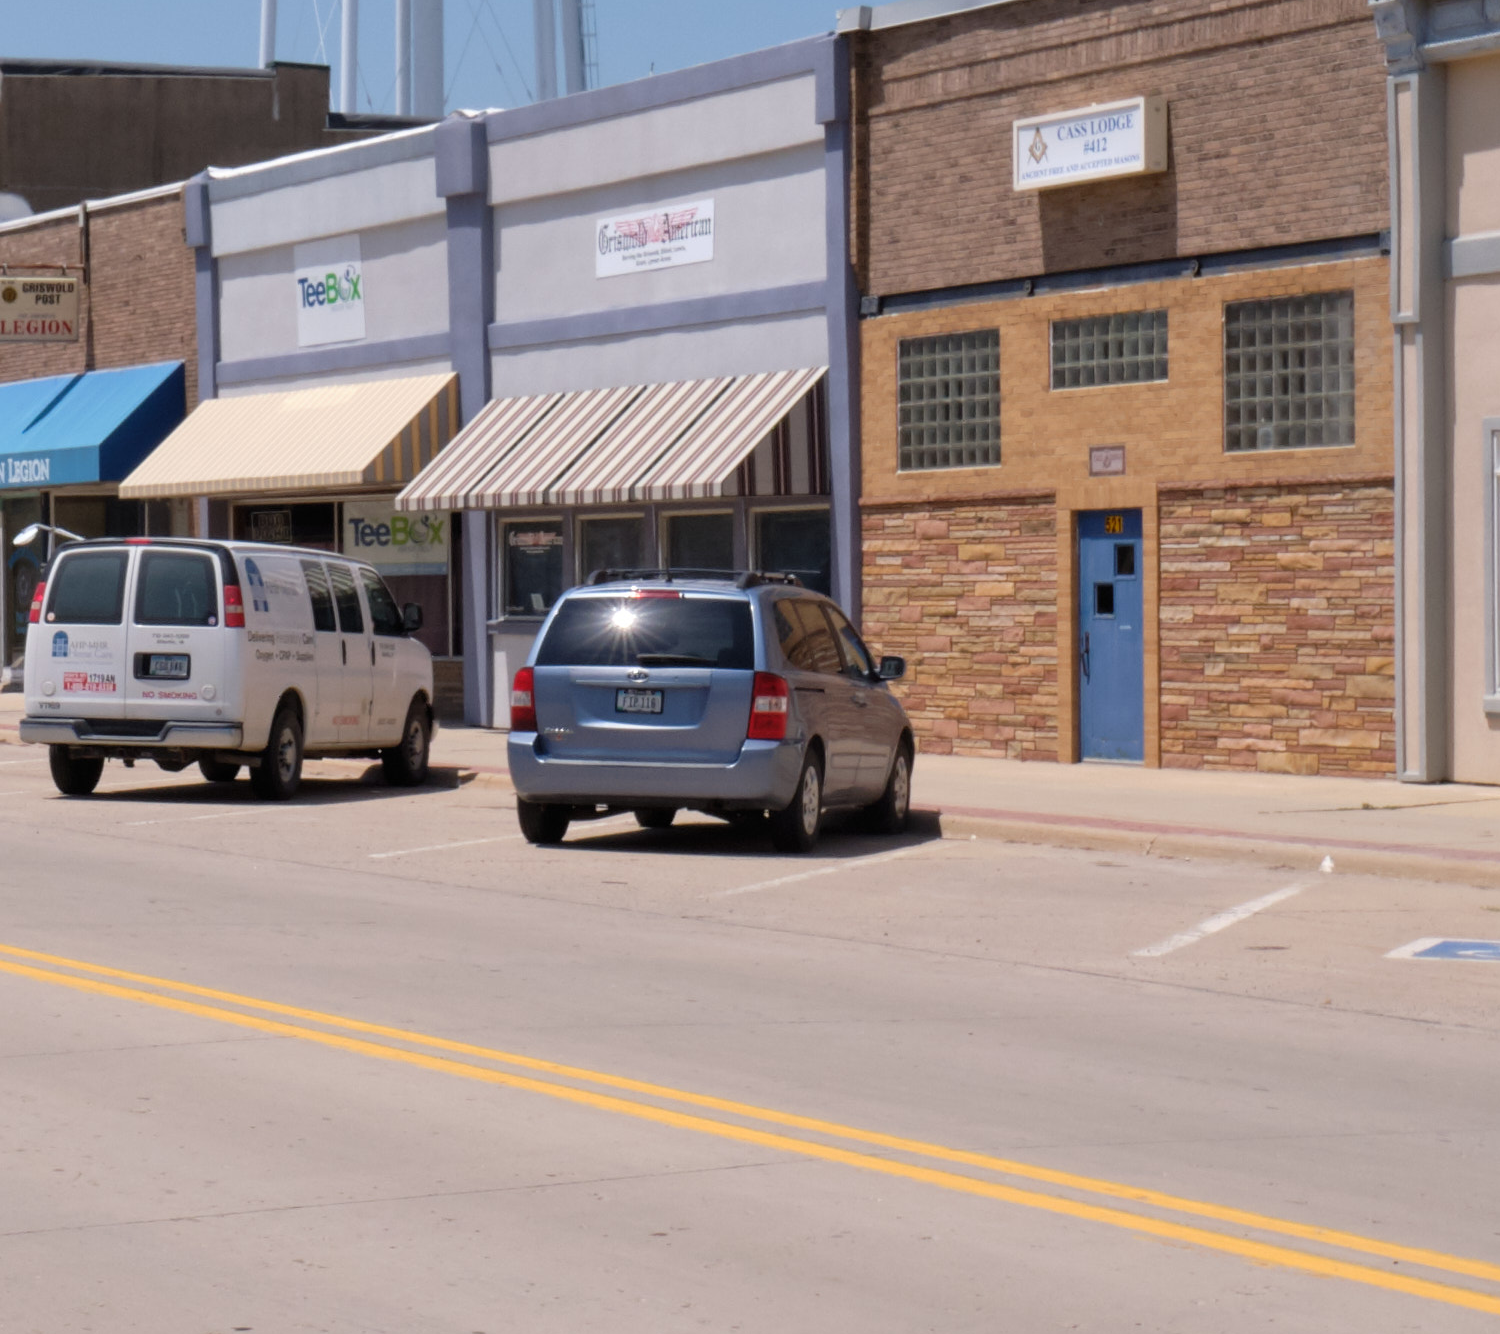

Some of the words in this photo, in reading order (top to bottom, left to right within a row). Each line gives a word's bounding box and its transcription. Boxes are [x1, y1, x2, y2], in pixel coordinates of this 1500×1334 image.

[1057, 122, 1088, 141] CASS
[1090, 113, 1134, 135] LODGE
[1083, 137, 1107, 155] #412
[22, 282, 74, 293] GRISWOLD
[35, 294, 61, 305] POST
[0, 319, 74, 336] LEGION
[7, 457, 50, 483] LEGION
[158, 691, 197, 700] SMOKING
